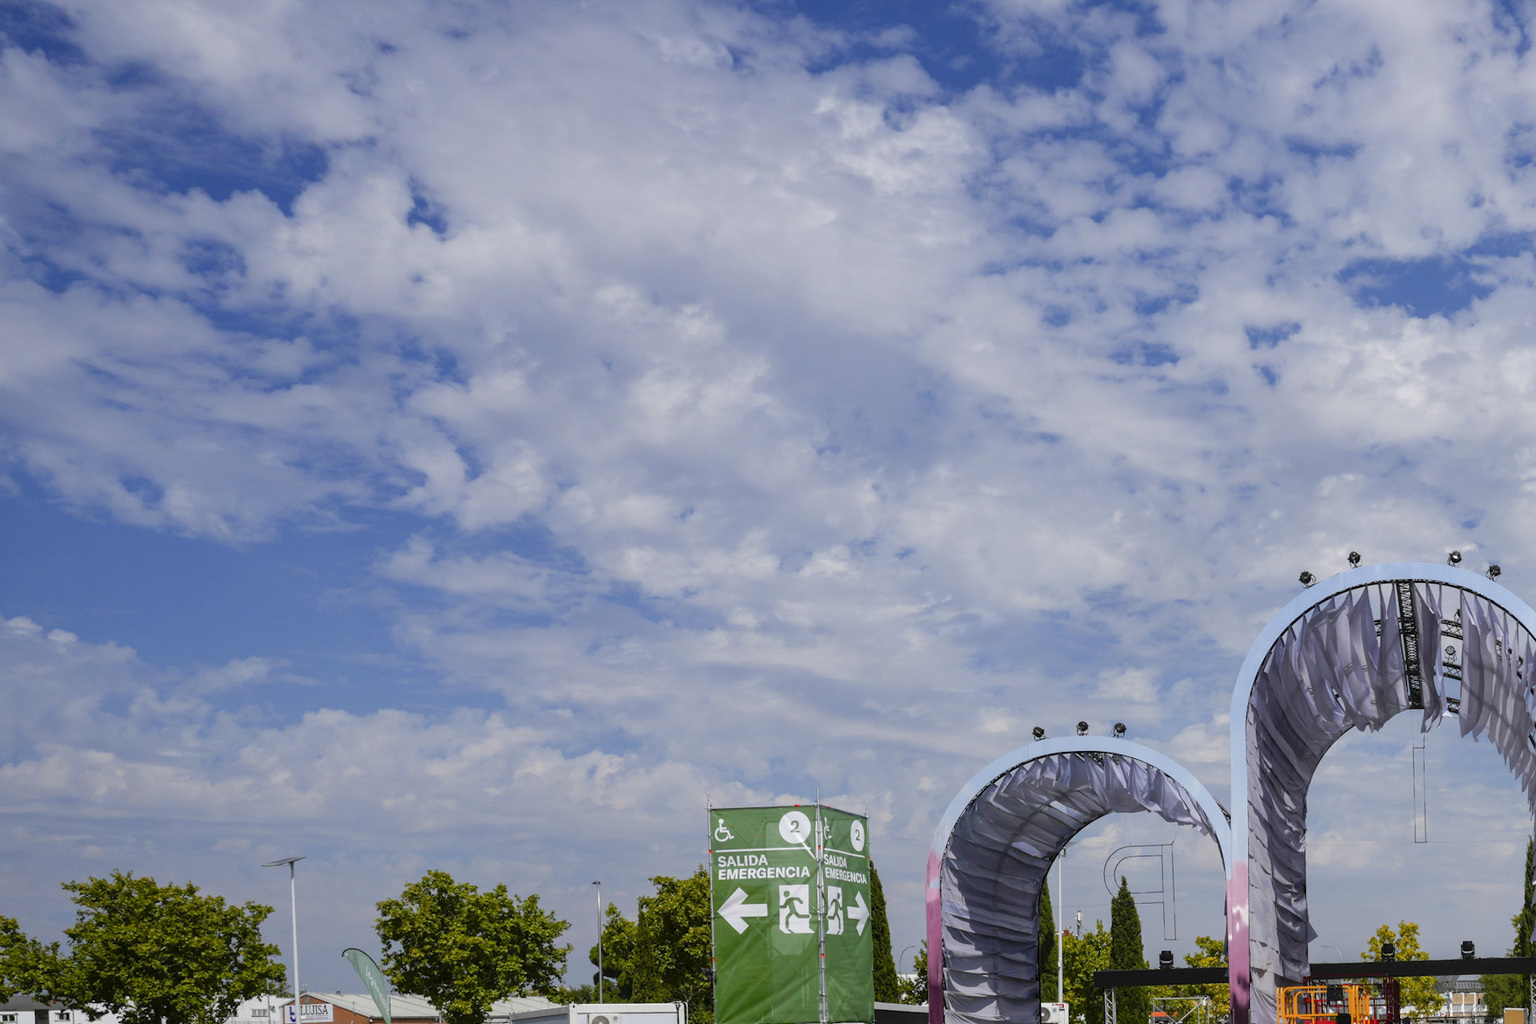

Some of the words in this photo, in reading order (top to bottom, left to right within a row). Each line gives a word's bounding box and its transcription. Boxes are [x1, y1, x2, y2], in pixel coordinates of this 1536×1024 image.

[790, 820, 800, 833] 2
[854, 829, 861, 842] 2
[718, 854, 768, 868] SALIDA
[824, 854, 848, 869] SALIDA
[718, 866, 810, 880] EMERGENCIA
[824, 868, 868, 884] EMERGENCIA
[300, 1005, 328, 1015] LUJISA
